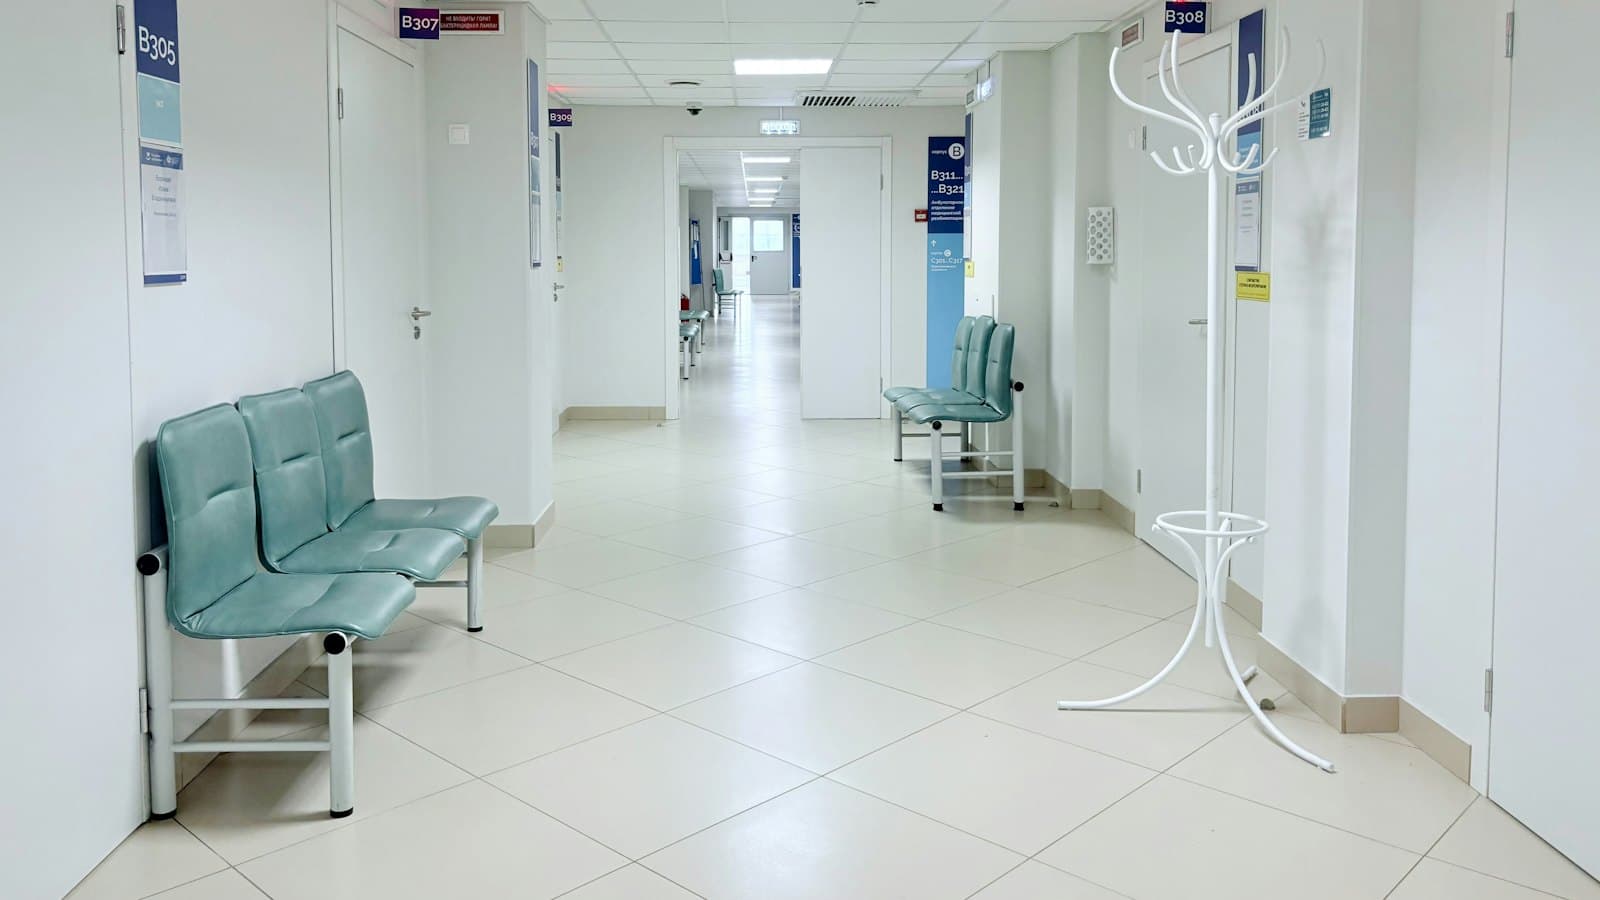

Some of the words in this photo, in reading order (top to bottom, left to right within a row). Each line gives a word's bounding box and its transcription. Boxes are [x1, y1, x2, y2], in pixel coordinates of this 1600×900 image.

[402, 15, 439, 31] B307
[1165, 9, 1204, 25] B308
[138, 25, 176, 66] B305
[549, 112, 572, 122] B309
